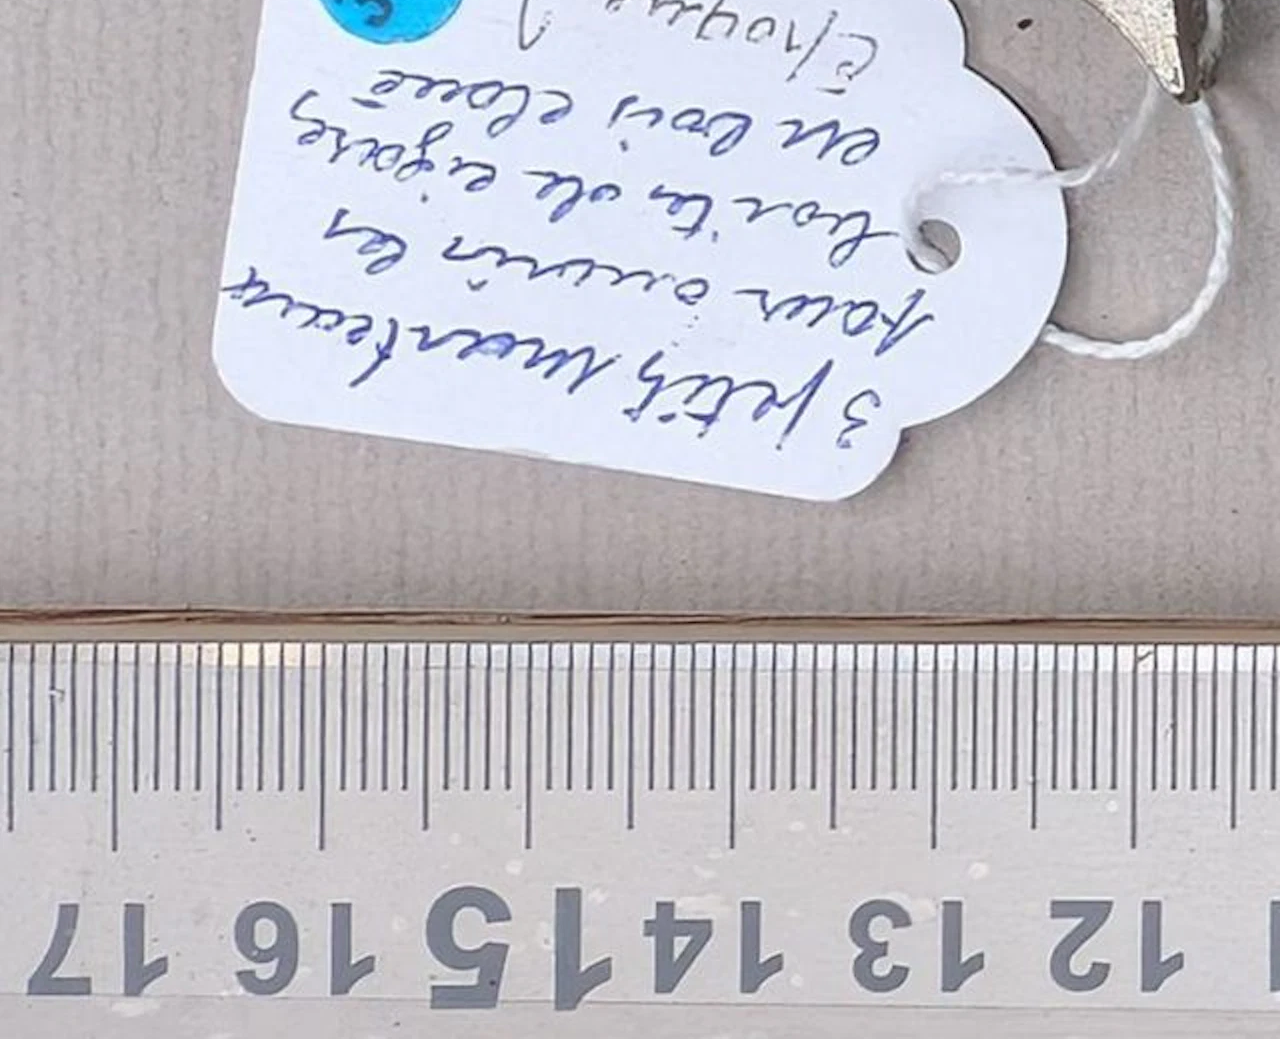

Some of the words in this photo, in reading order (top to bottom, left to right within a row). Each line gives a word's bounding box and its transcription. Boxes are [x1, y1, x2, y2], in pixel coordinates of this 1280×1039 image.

[290, 90, 497, 203] cigares
[608, 96, 752, 156] bois
[775, 119, 880, 165] en
[323, 208, 407, 274] les
[523, 170, 621, 222] de
[442, 236, 709, 305] ouvrir
[221, 266, 621, 394] marteaux
[734, 289, 934, 356] pour
[623, 351, 834, 451] petits
[837, 390, 881, 448] 3
[26, 902, 168, 996] 17
[235, 901, 375, 995] 16
[425, 885, 612, 1011] 15
[643, 900, 783, 994] 14
[849, 899, 984, 993] 13
[1050, 899, 1184, 992] 12
